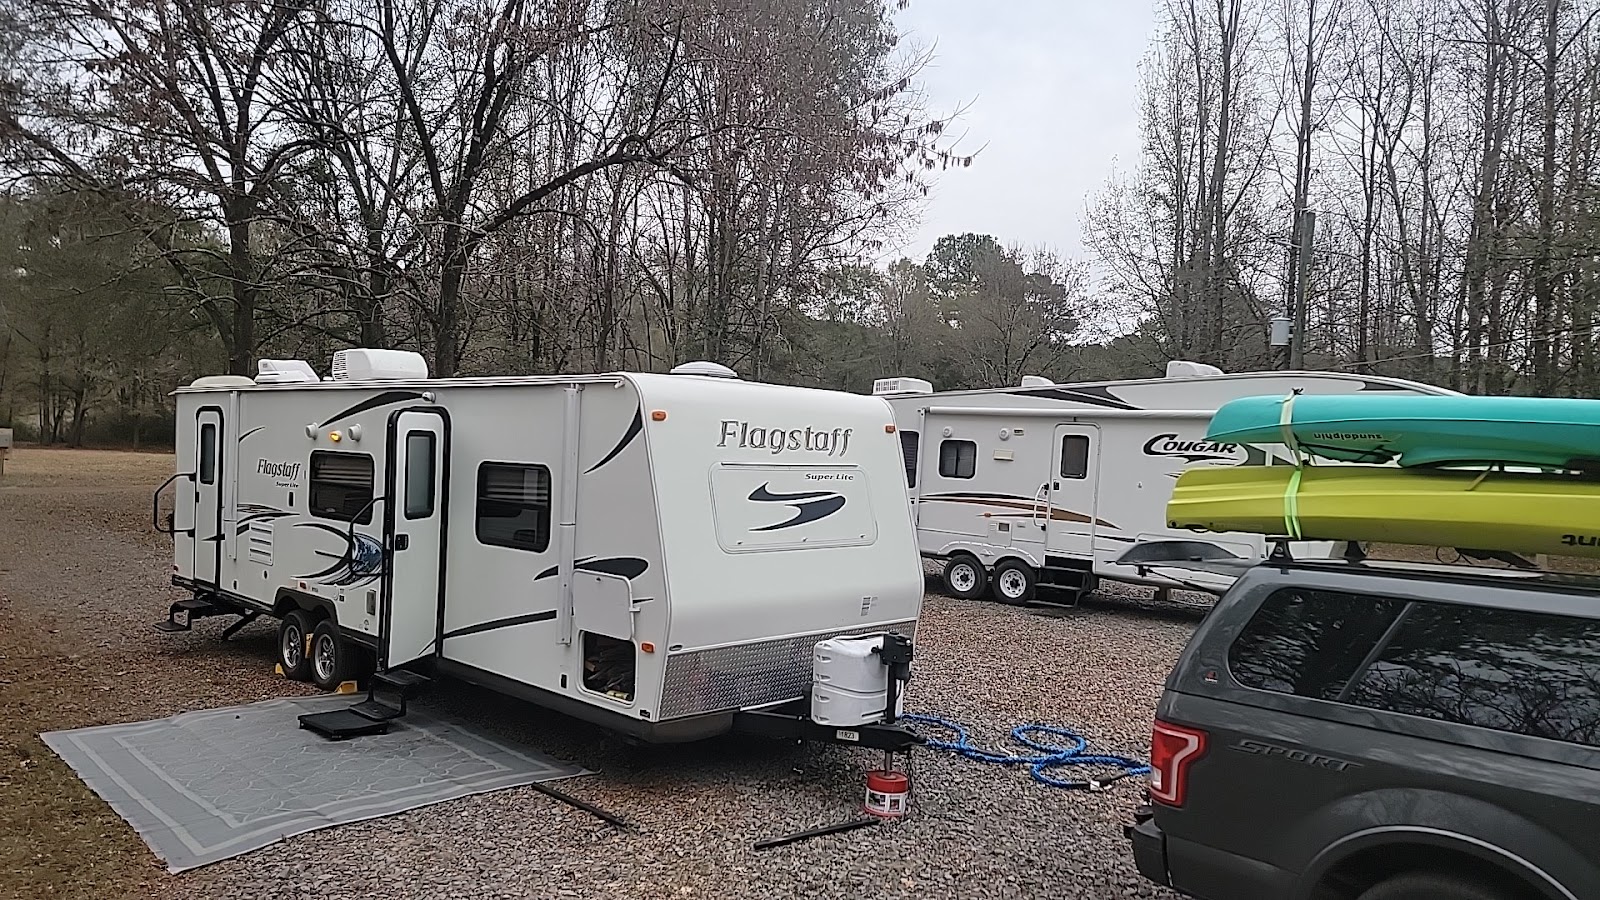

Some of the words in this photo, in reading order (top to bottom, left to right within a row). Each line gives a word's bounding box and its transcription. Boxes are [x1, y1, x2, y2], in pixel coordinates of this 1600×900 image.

[717, 419, 853, 457] Flagstaff
[1143, 433, 1237, 456] COUGAR
[1313, 432, 1383, 440] sundolphin
[257, 458, 301, 480] Flagstaff
[805, 473, 834, 481] Super
[836, 473, 854, 481] Lite
[1228, 739, 1365, 772] SPORT
